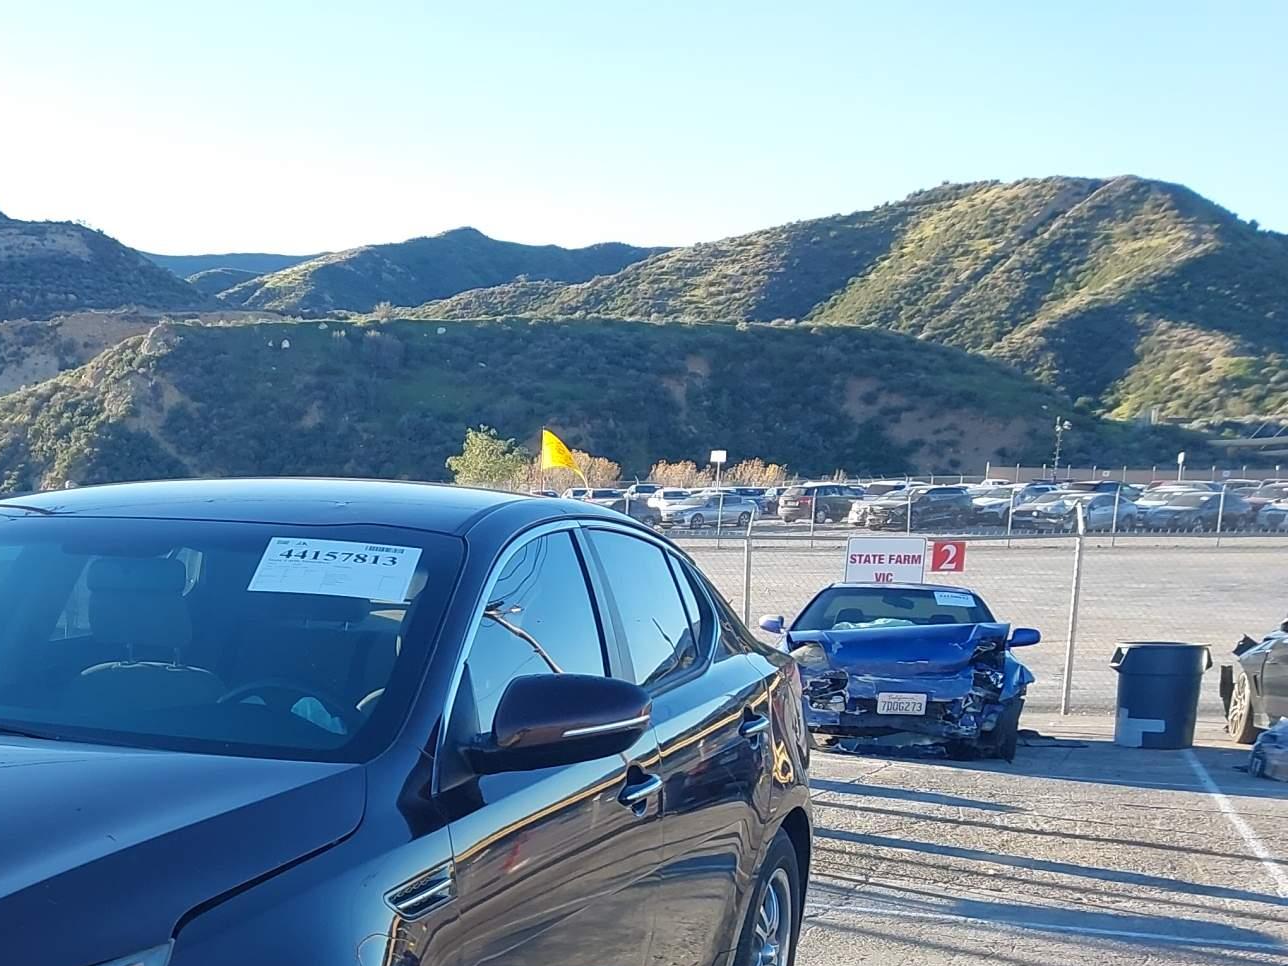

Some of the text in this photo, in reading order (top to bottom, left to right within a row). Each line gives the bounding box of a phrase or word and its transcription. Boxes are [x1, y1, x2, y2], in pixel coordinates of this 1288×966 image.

[279, 549, 398, 567] 44157813
[849, 554, 922, 565] STATE FARM
[938, 544, 957, 570] 2
[874, 572, 894, 583] VIC
